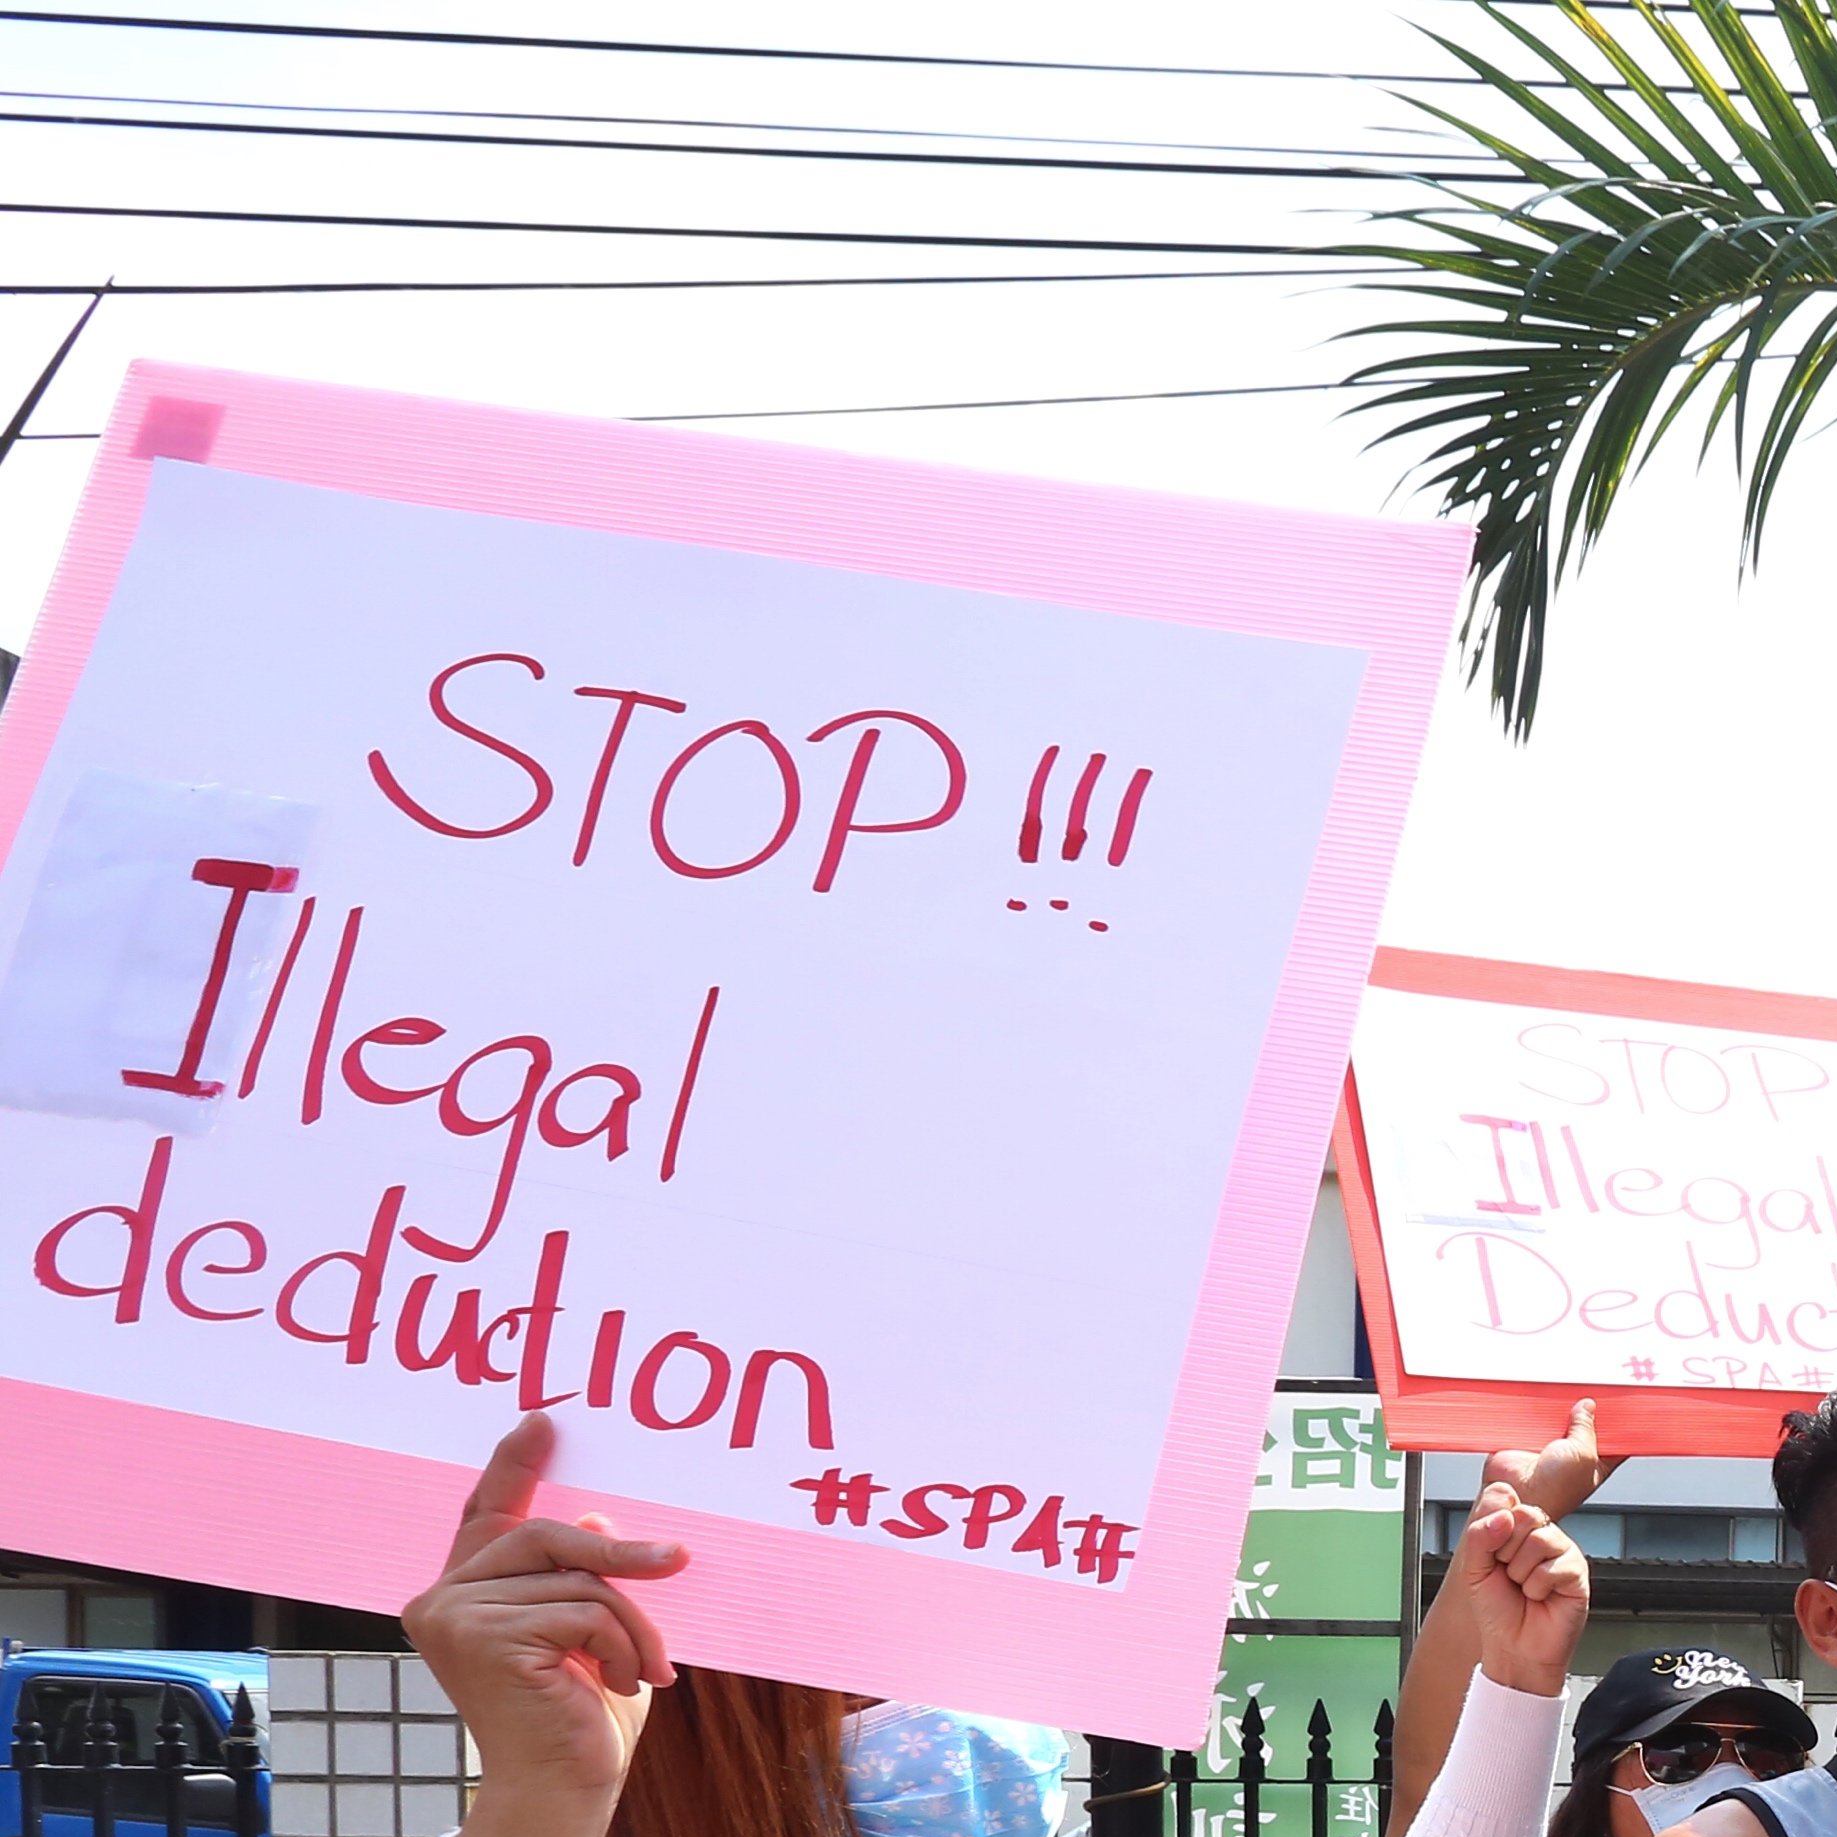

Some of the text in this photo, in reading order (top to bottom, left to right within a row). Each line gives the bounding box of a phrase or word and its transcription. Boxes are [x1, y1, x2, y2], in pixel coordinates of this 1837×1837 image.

[367, 652, 967, 893] STOP
[122, 858, 720, 1260] Illegal
[1516, 1022, 1830, 1123] STOP
[33, 1135, 835, 1452] deduction
[1673, 1663, 1753, 1691] York
